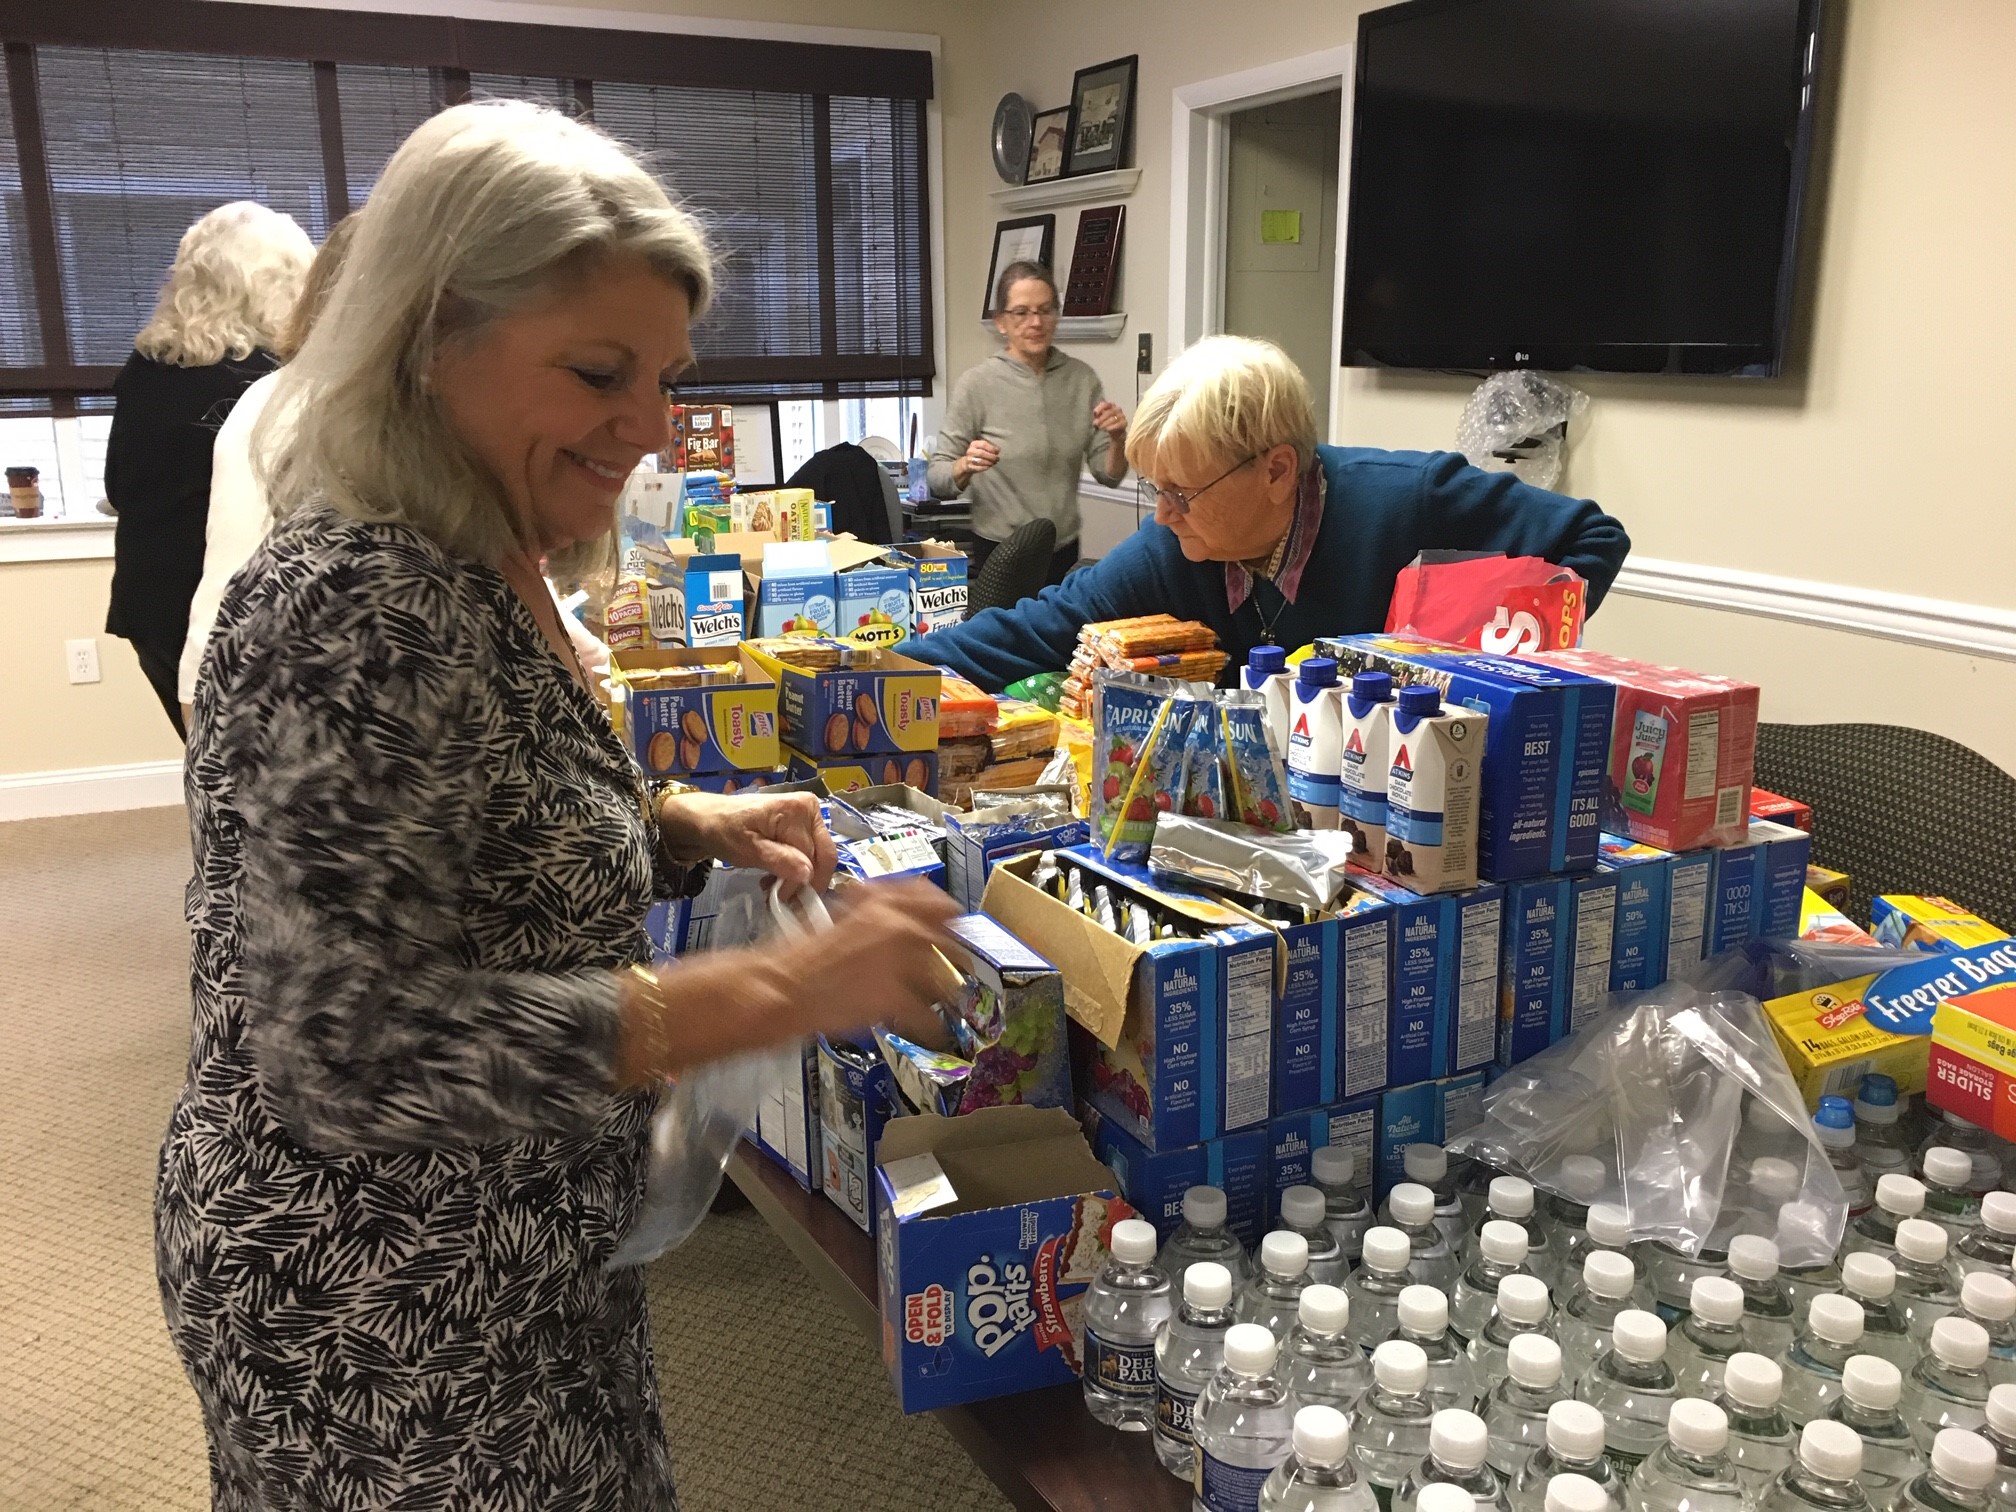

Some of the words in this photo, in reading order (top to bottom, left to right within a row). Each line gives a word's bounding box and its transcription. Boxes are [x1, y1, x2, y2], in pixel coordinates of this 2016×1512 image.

[687, 438, 701, 452] Fig
[703, 438, 719, 450] Bar
[920, 563, 934, 572] 80
[616, 583, 638, 596] PACKS
[920, 589, 966, 609] Welch's
[609, 609, 619, 622] 10
[618, 607, 641, 617] PACKS
[649, 594, 684, 630] Welch's
[693, 615, 740, 635] Welch's
[933, 619, 958, 632] Fruit
[609, 633, 619, 642] 10
[619, 628, 641, 639] PACKS
[846, 679, 854, 711] Peanut
[660, 697, 668, 727] Butter
[670, 696, 680, 728] Peanut
[898, 689, 911, 731] Toasty
[731, 704, 744, 749] Toasty
[1636, 721, 1666, 739] Juicy
[1636, 731, 1661, 743] Juice
[1524, 741, 1550, 756] BEST
[1344, 752, 1363, 761] ATKINS
[1347, 762, 1359, 770] DARK
[1343, 767, 1365, 779] CHOCOLATE
[1345, 775, 1361, 783] ROYALE
[1392, 768, 1411, 779] ATKINS
[1389, 784, 1412, 796] CHOCOLATE
[1394, 780, 1406, 788] DARK
[1392, 792, 1408, 802] ROYALE
[1571, 798, 1585, 812] IT'S
[1586, 797, 1599, 810] ALL
[1513, 818, 1547, 829] all-natural
[1570, 813, 1597, 828] GOOD.
[1509, 829, 1546, 842] ingredients.
[1631, 880, 1642, 890] ALL
[1622, 888, 1649, 900] NATURAL
[1726, 884, 1751, 900] GOOD.
[1536, 897, 1547, 907] ALL
[1464, 910, 1485, 918] Nutrition
[1527, 906, 1555, 919] NATURAL
[1626, 910, 1643, 921] 50%
[1724, 902, 1738, 916] ALL
[1415, 915, 1428, 926] ALL
[1348, 932, 1371, 941] Nutrition
[1405, 924, 1437, 938] NATURAL
[1531, 928, 1549, 940] 35%
[1297, 937, 1310, 948] ALL
[1405, 934, 1436, 942] INGREDIENTS
[1288, 945, 1320, 959] NATURAL
[1410, 947, 1430, 958] 35%
[1626, 947, 1638, 957] NO
[1229, 958, 1255, 970] Nutrition
[1255, 954, 1272, 964] Facts
[1405, 958, 1418, 966] LESS
[1174, 967, 1187, 979] ALL
[1292, 969, 1314, 982] 35%
[1531, 966, 1544, 976] NO
[1164, 976, 1198, 992] NATURAL
[1623, 980, 1636, 990] NO
[1868, 971, 1968, 1023] Freezer
[1951, 945, 2016, 983] Bags
[1164, 986, 1198, 997] INGREDIENTS
[1411, 986, 1425, 996] NO
[1169, 1001, 1192, 1015] 35%
[1529, 1000, 1542, 1010] NO
[1164, 1014, 1179, 1023] LESS
[1180, 1011, 1196, 1020] SUGAR
[1295, 1008, 1310, 1020] NO
[1822, 1002, 1862, 1028] ShopRite
[1410, 1020, 1424, 1032] NO
[1802, 1039, 1820, 1053] 14
[1838, 1033, 1860, 1044] GALLON
[1860, 1030, 1874, 1038] SIZE
[1988, 1040, 2004, 1056] Bags
[1173, 1042, 1188, 1055] NO
[1295, 1044, 1310, 1056] NO
[1176, 1052, 1197, 1062] Fructose
[1180, 1060, 1194, 1068] Syrup
[1937, 1058, 1957, 1071] BAGS
[1959, 1067, 1993, 1088] STORAGE
[1966, 1064, 1994, 1081] GALLON
[1174, 1080, 1189, 1092] NO
[1937, 1065, 1992, 1101] SLIDER
[1331, 1121, 1356, 1129] Nutrition
[1387, 1120, 1420, 1133] Natural
[1398, 1115, 1411, 1125] All
[1286, 1131, 1298, 1142] ALL
[1276, 1140, 1308, 1154] NATURAL
[1276, 1150, 1309, 1160] INGREDIENTS
[1228, 1164, 1256, 1174] Everything
[1281, 1163, 1302, 1176] 35%
[1164, 1201, 1184, 1217] BES
[1028, 1212, 1038, 1244] Friendly
[1036, 1252, 1062, 1333] Strawberry
[927, 1286, 943, 1329] FOLD
[908, 1296, 924, 1340] OPEN
[945, 1325, 952, 1334] TO
[927, 1332, 942, 1344] &
[1119, 1354, 1154, 1369] DEE
[1119, 1368, 1155, 1382] PAR
[1172, 1400, 1194, 1416] DE
[1173, 1415, 1193, 1429] PA
